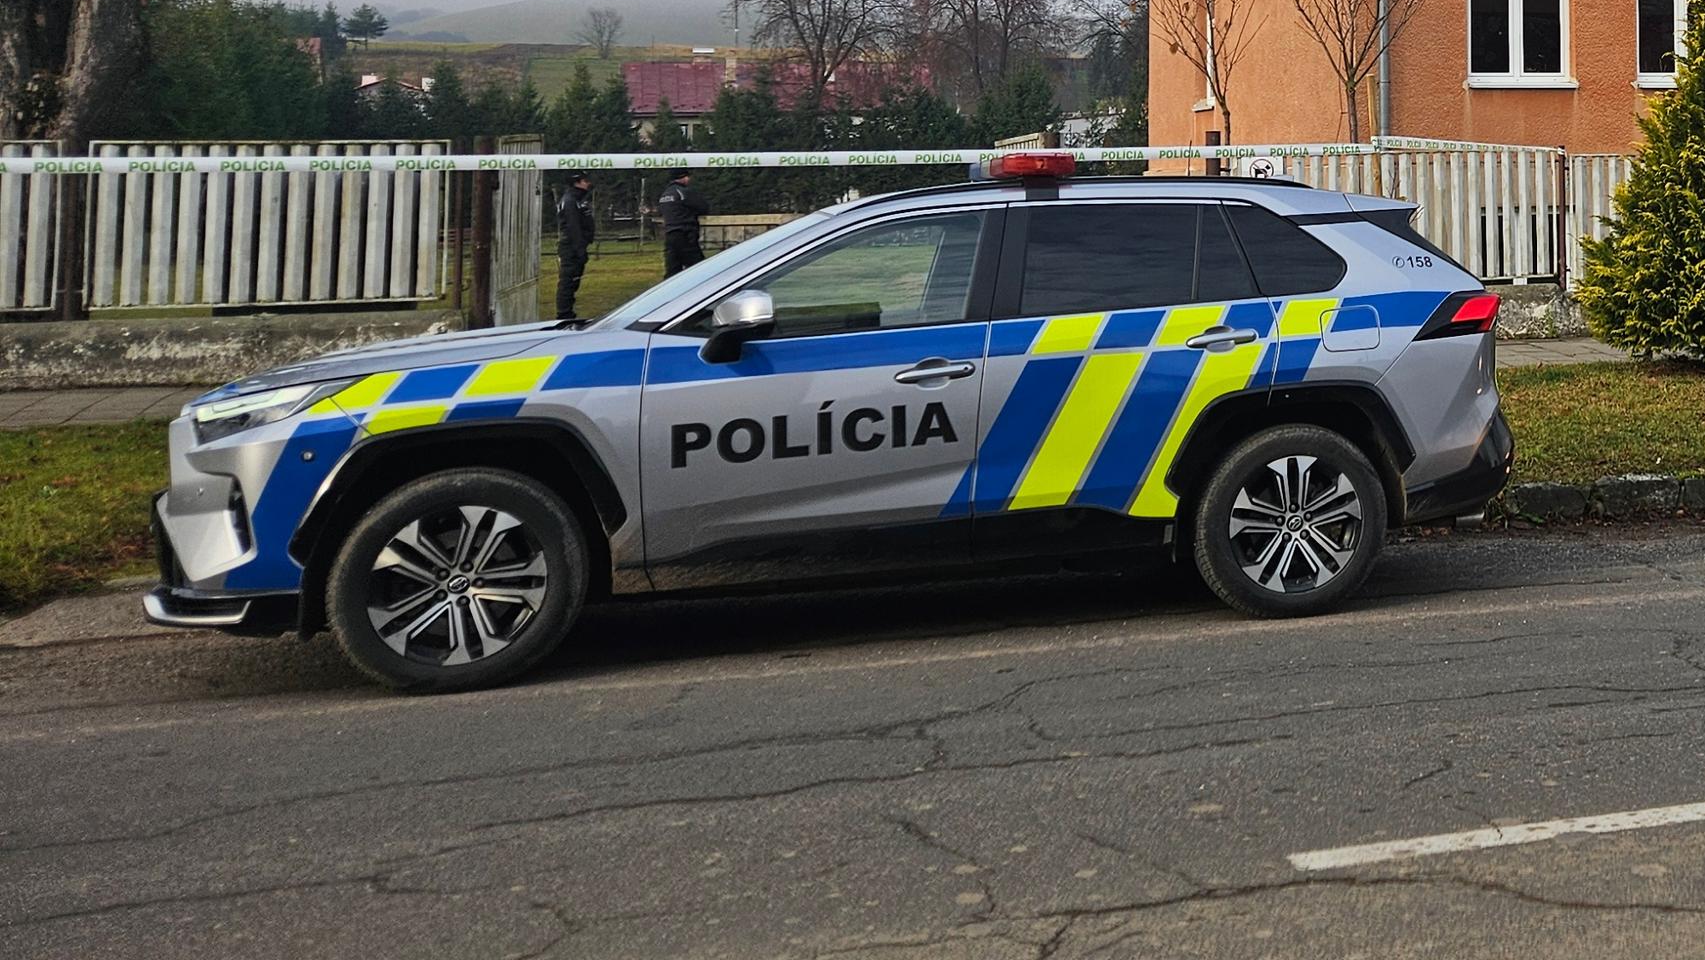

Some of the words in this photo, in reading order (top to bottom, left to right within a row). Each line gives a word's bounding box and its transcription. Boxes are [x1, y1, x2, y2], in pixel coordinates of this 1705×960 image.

[34, 158, 104, 172] POLÍCIA
[129, 159, 196, 172] POLÍCIA
[220, 159, 286, 172] POLÍCIA
[309, 158, 372, 171] POLÍCIA
[396, 157, 456, 170] POLÍCIA
[479, 157, 537, 169] POLÍCIA
[558, 156, 613, 168] POLÍCIA
[634, 155, 688, 167] POLÍCIA
[708, 155, 760, 166] POLÍCIA
[779, 154, 830, 165] POLÍCIA
[849, 152, 897, 164] POLÍCIA
[915, 152, 962, 163] POLÍCIA
[1101, 149, 1144, 160] POLÍCIA
[1159, 148, 1201, 159] POLÍCIA
[1215, 146, 1256, 158] POLÍCIA
[1270, 145, 1309, 157] POLÍCIA
[1322, 143, 1361, 155] POLÍCIA
[1407, 255, 1433, 268] 158
[670, 400, 959, 469] POLÍCIA
